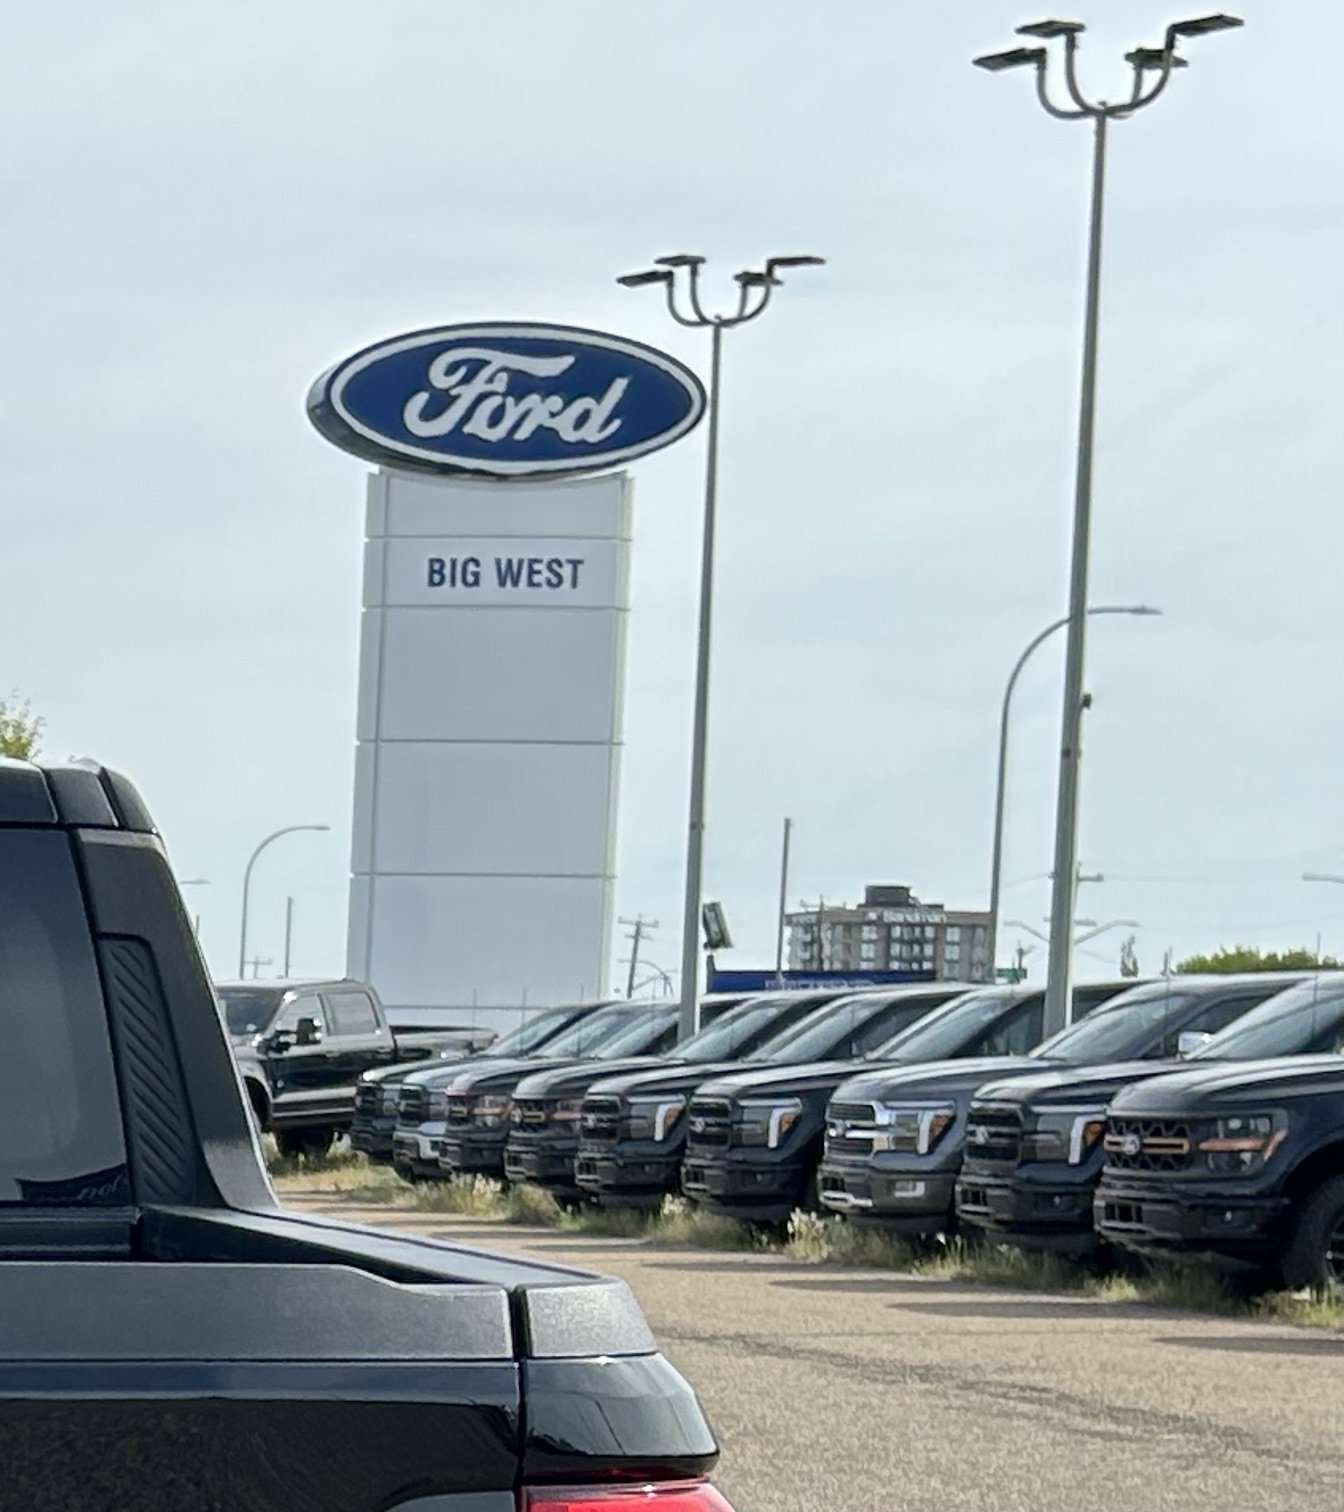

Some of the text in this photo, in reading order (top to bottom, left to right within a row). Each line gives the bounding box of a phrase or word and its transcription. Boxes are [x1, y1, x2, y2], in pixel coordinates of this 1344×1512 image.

[403, 347, 629, 443] Ford
[427, 556, 585, 589] BIG WEST
